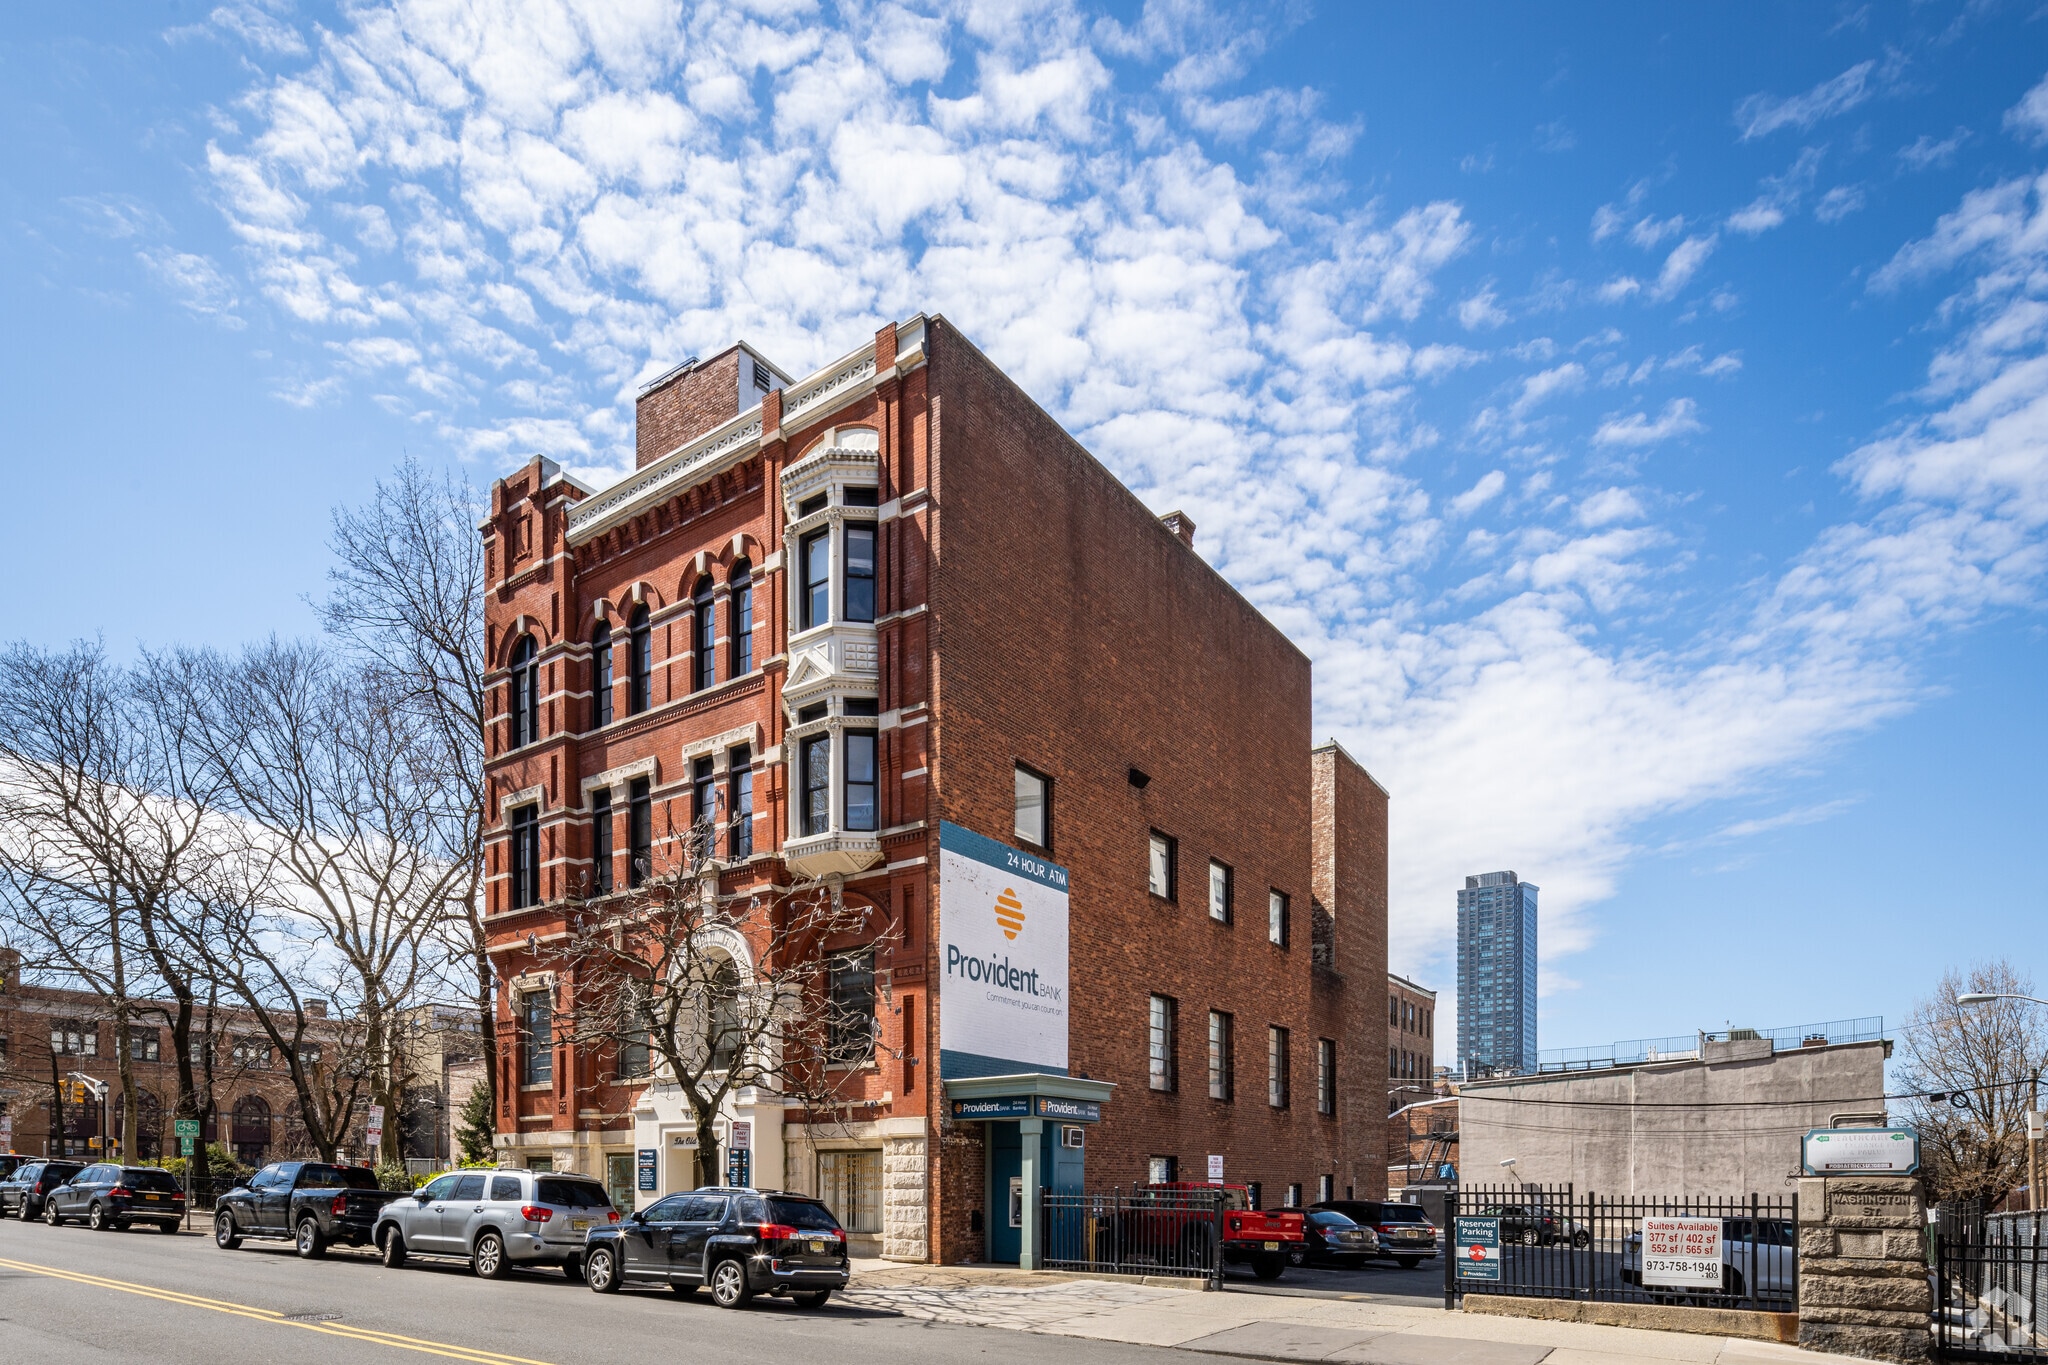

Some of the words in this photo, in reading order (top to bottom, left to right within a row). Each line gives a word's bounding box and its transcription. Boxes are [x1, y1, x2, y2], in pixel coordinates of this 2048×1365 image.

[1007, 852, 1019, 868] 24
[1021, 858, 1045, 878] HOUR
[1049, 870, 1066, 886] ATM
[948, 944, 1039, 996] Provident
[1040, 983, 1062, 1001] BANK
[986, 992, 1020, 1007] Commitment
[1022, 1001, 1032, 1010] you
[1041, 1005, 1055, 1014] count
[963, 1102, 999, 1113] Provident
[1047, 1099, 1078, 1114] Provident
[674, 1137, 684, 1145] The
[685, 1137, 697, 1145] Old
[1831, 1193, 1910, 1205] WASHINGTON
[1862, 1207, 1882, 1216] ST.
[1265, 1220, 1281, 1228] Jeep
[1648, 1222, 1675, 1230] Suites
[1677, 1223, 1718, 1231] Available
[1462, 1228, 1493, 1237] Parking
[1649, 1233, 1666, 1242] 377
[1669, 1233, 1678, 1242] sf
[1686, 1234, 1703, 1243] 402
[1706, 1235, 1716, 1243] sf
[1652, 1244, 1667, 1253] 552
[1670, 1245, 1678, 1253] sf
[1686, 1246, 1702, 1254] 565
[1704, 1246, 1714, 1254] sf
[1646, 1261, 1718, 1272] 973-758-1940
